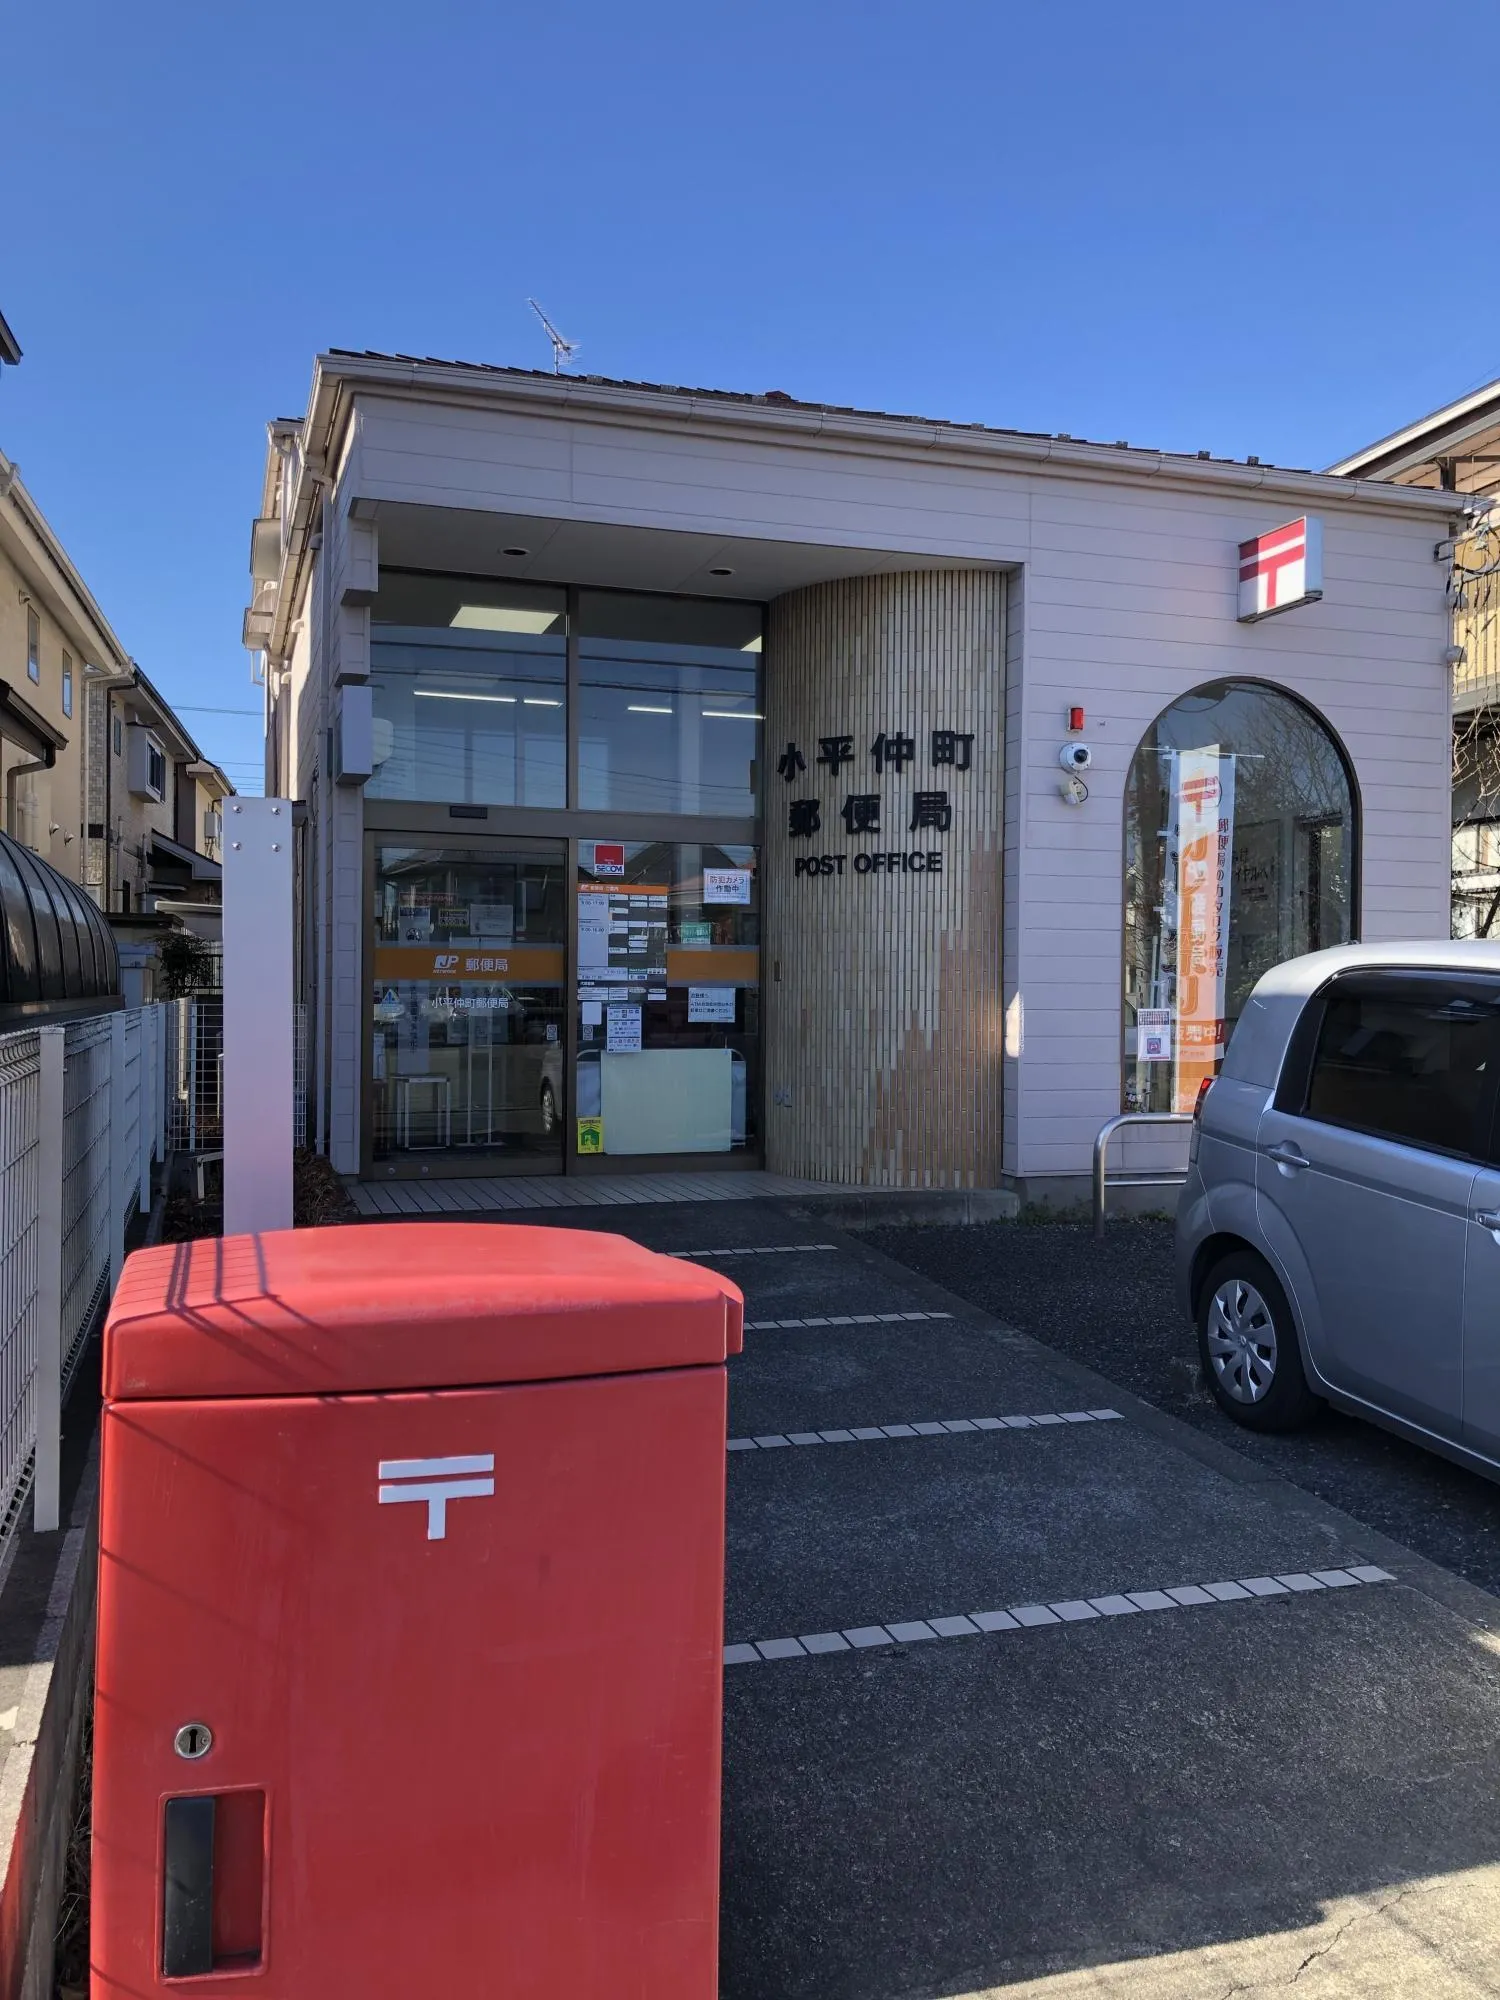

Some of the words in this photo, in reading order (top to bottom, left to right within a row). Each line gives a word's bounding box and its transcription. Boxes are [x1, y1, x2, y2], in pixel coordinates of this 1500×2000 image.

[777, 730, 975, 782] 小平仲町
[788, 791, 952, 838] 郵便局
[596, 865, 623, 873] SECOM
[794, 854, 848, 878] POST
[854, 851, 943, 874] OFFICE
[710, 875, 745, 885] 防犯カメラ
[465, 957, 509, 973] 郵便局
[431, 997, 509, 1009] 小平仲町郵便局
